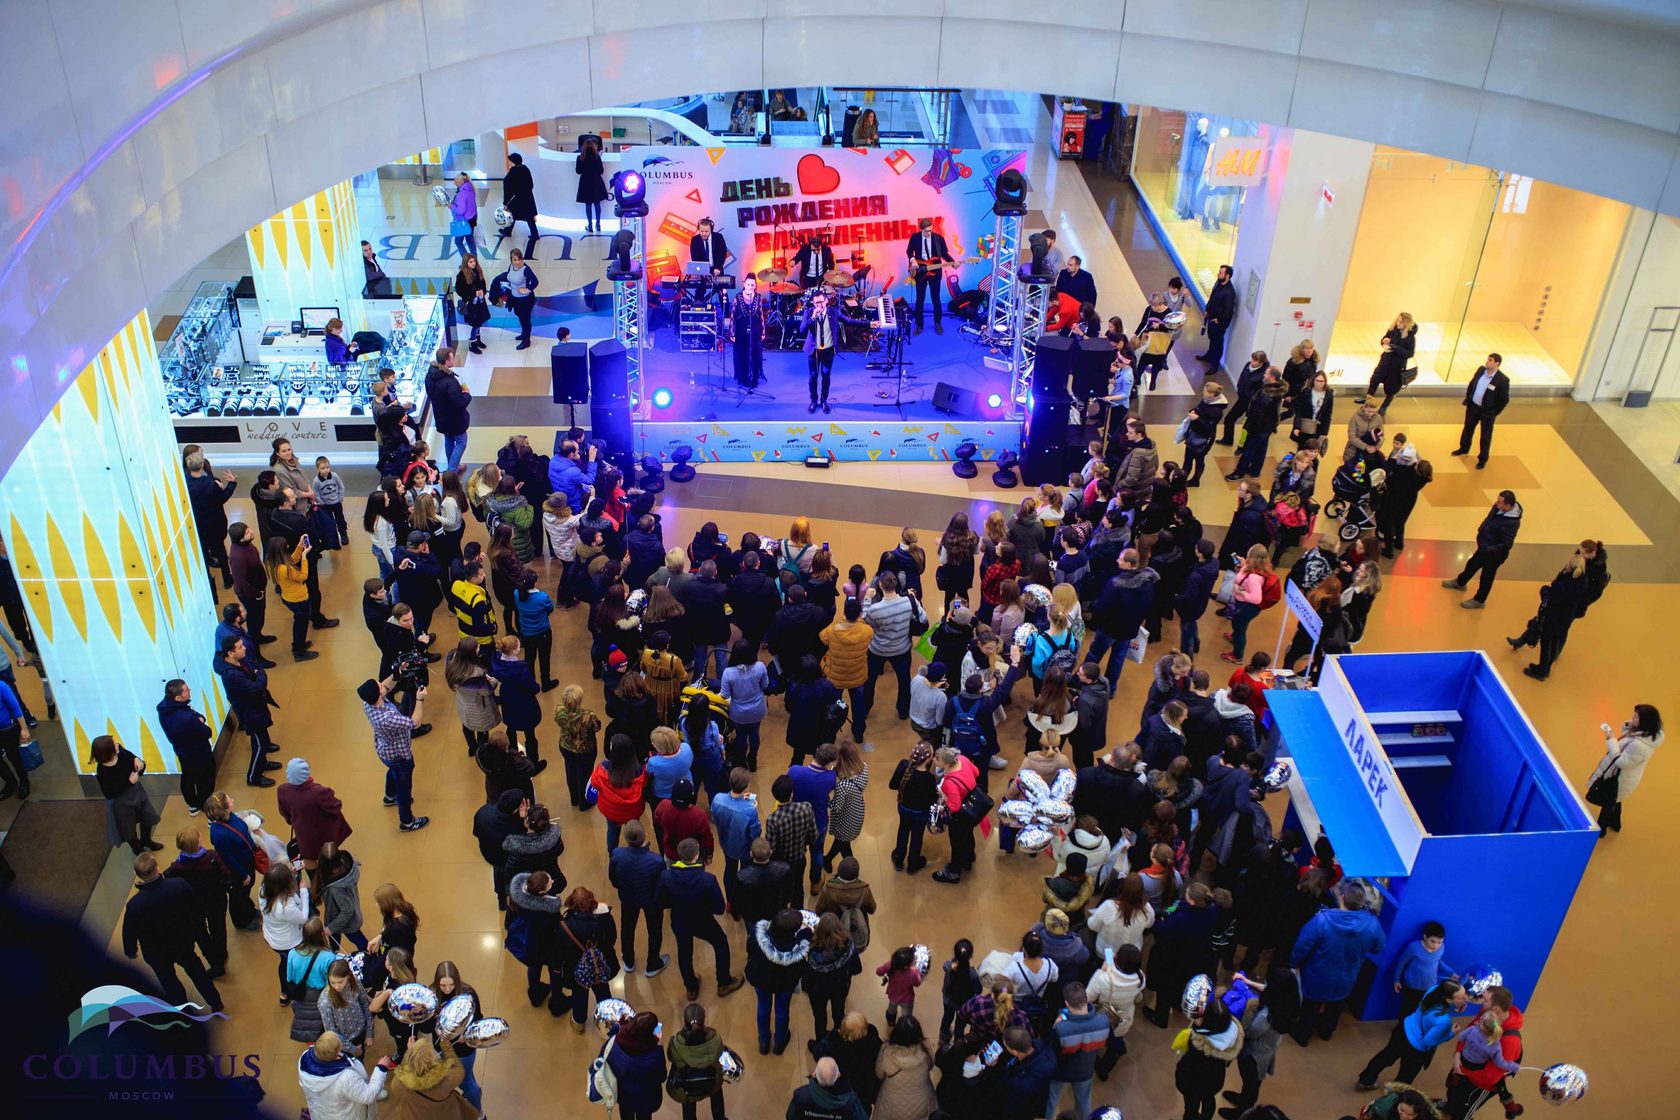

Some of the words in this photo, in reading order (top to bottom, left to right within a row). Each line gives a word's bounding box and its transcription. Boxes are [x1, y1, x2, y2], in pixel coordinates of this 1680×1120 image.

[639, 171, 693, 179] OLUMBUS
[720, 177, 793, 203] ДЕНЬ
[737, 195, 888, 228] РОЖДЕНИЯ
[1345, 718, 1388, 810] ЛАРЕК
